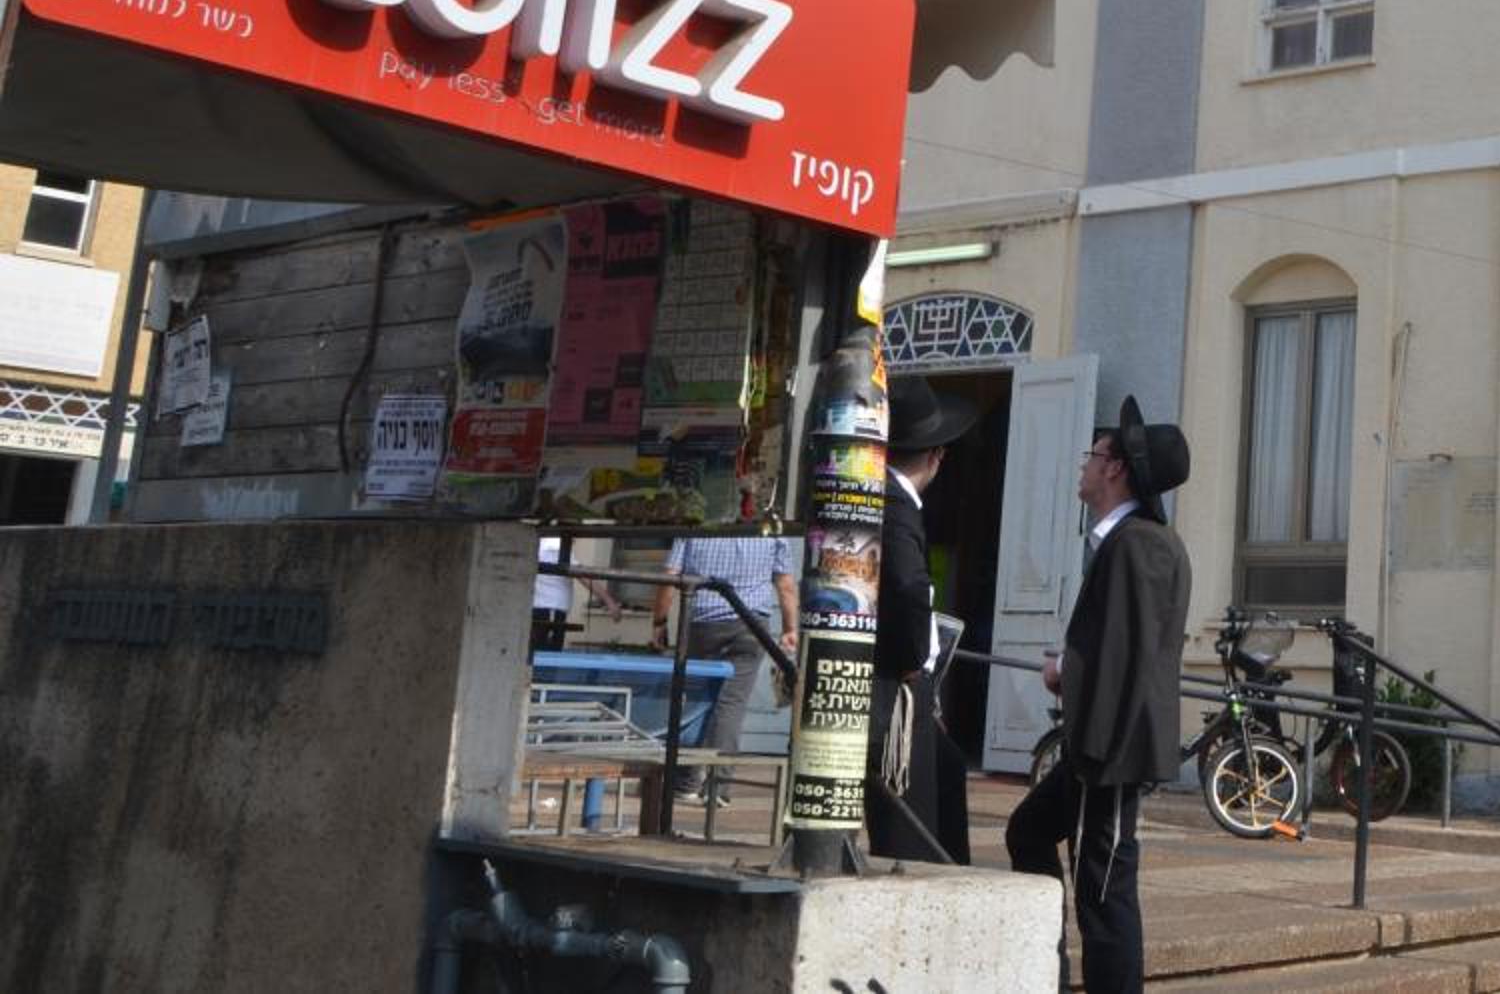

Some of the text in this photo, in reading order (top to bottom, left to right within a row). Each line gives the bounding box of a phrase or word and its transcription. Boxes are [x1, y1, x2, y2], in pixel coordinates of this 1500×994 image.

[199, 3, 254, 38] כשר
[379, 50, 433, 89] pay
[447, 72, 507, 104] less
[537, 96, 586, 126] get
[791, 150, 875, 217] קופיז
